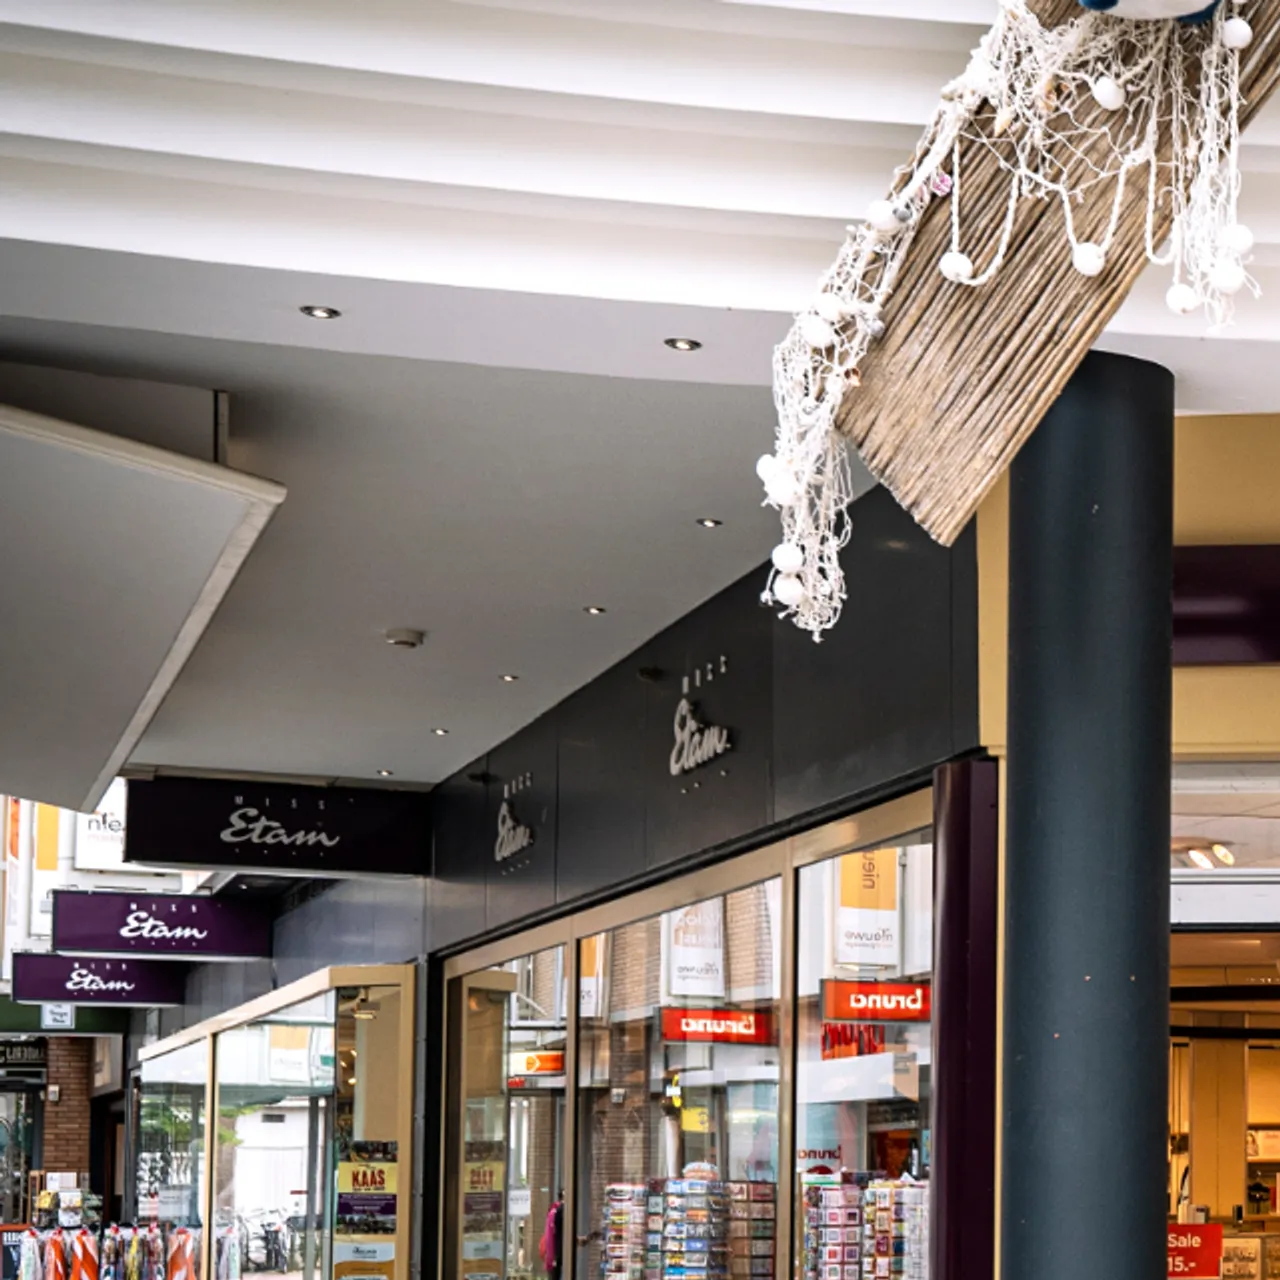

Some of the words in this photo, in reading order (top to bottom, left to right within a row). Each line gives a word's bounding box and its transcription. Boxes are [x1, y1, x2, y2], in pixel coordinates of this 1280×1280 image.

[219, 807, 341, 847] Etam
[119, 911, 208, 939] Etam
[65, 968, 135, 990] Etam
[352, 1169, 385, 1188] KAAS
[1167, 1232, 1201, 1248] Sale
